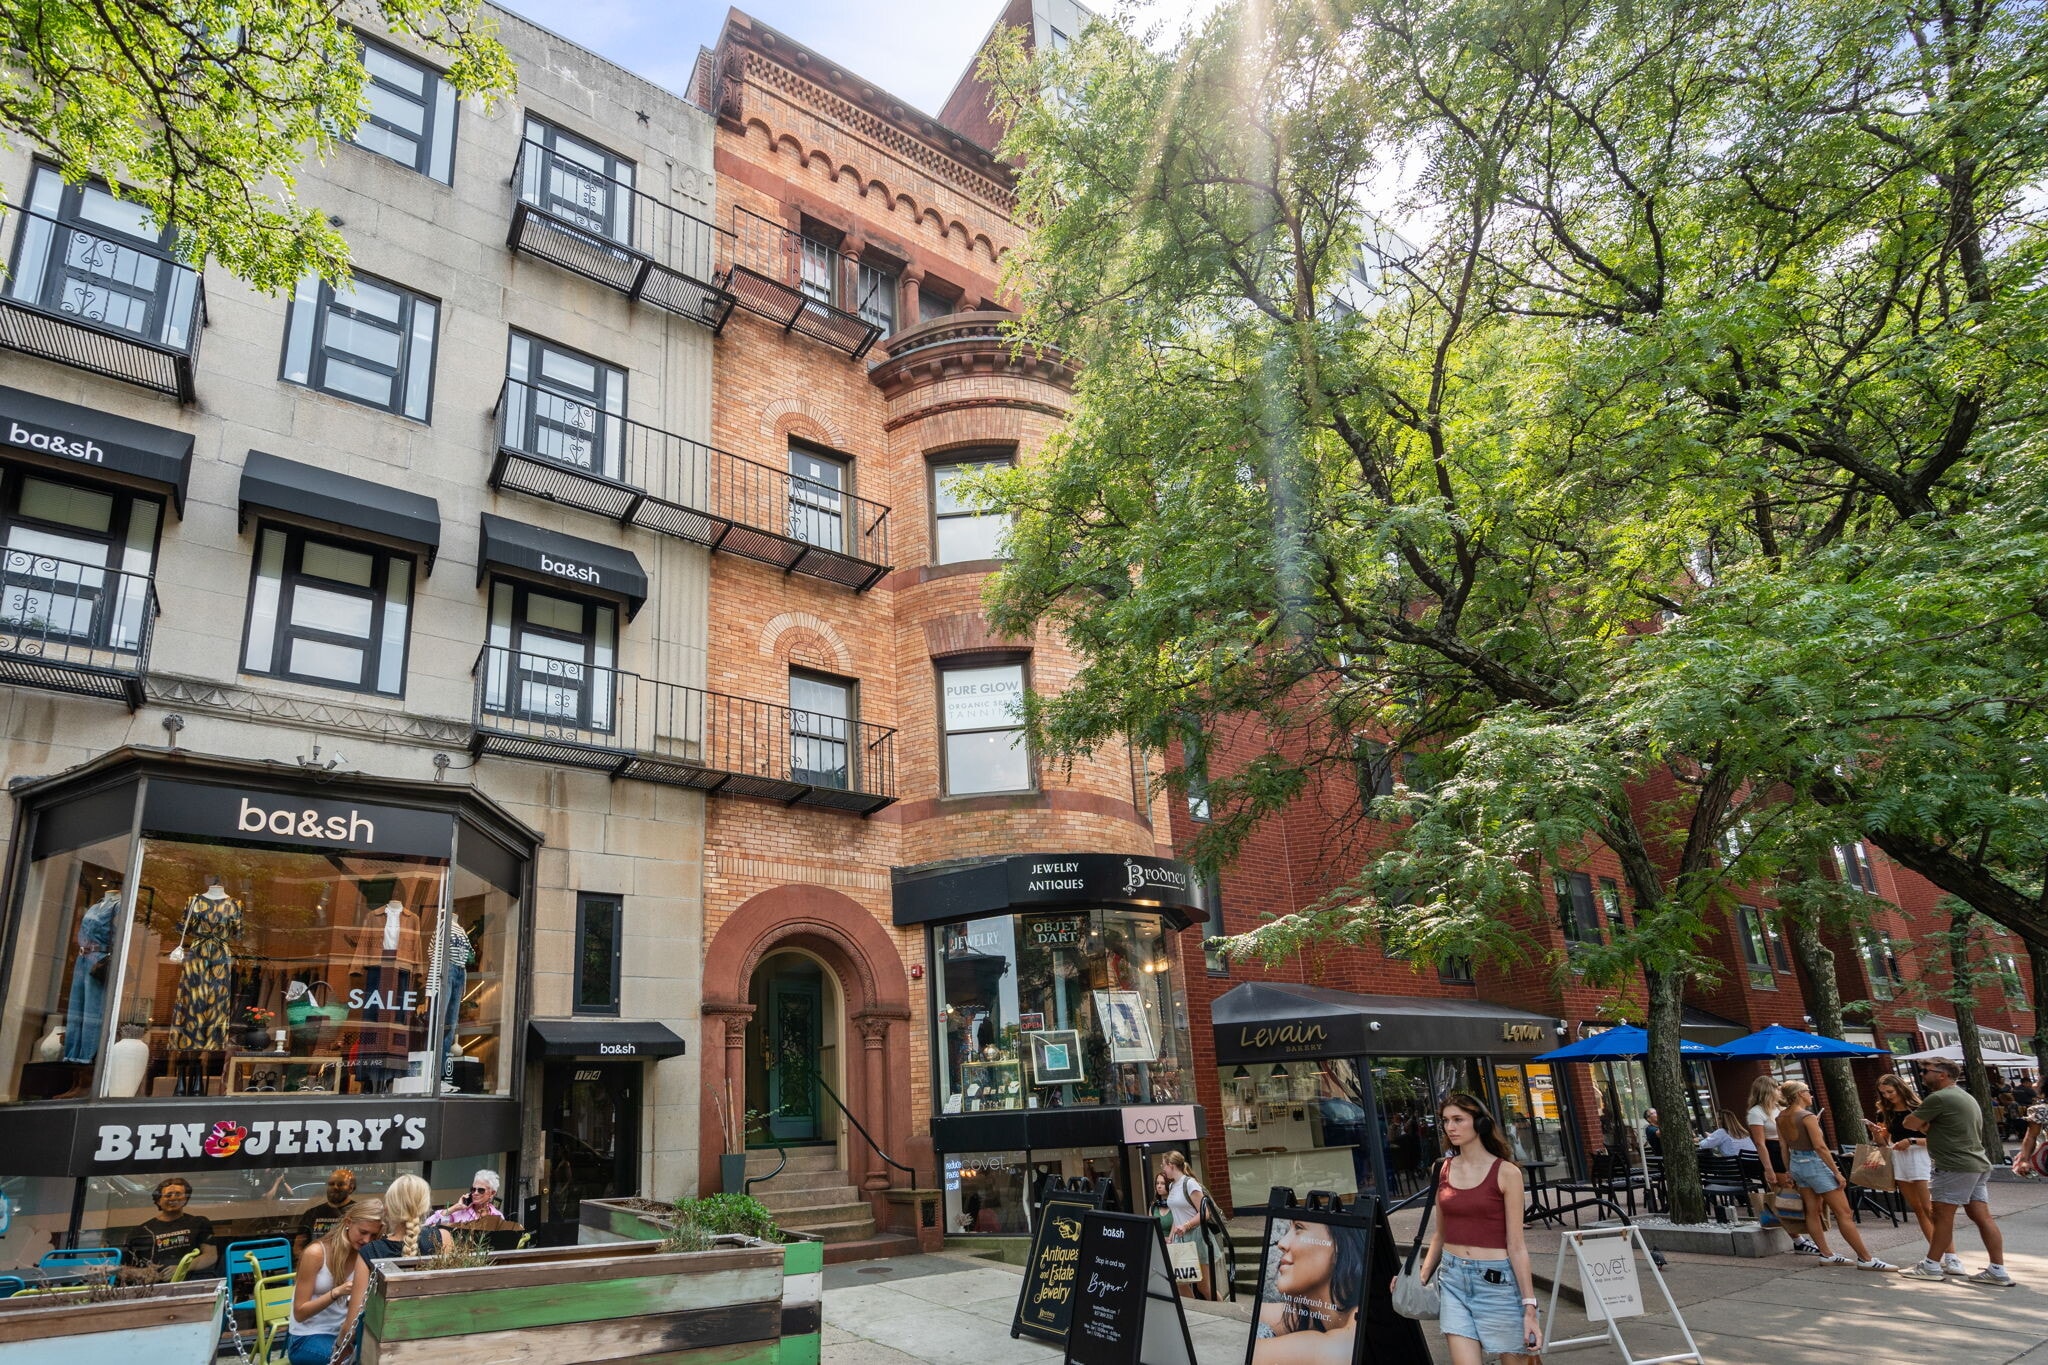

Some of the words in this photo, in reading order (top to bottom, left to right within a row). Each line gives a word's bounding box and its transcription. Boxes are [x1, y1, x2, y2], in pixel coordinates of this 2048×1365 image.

[9, 422, 104, 463] ba&sh
[541, 554, 600, 584] ba&sh
[946, 684, 977, 697] PURE
[980, 681, 1019, 694] GLOW
[948, 700, 990, 710] ORGANIC
[949, 709, 1005, 719] TANNIN
[238, 797, 375, 844] ba&sh
[1031, 862, 1080, 875] JEWELRY
[1122, 857, 1187, 896] Brodney
[1028, 879, 1084, 892] ANTIQUES
[1033, 920, 1079, 933] OBJET
[952, 930, 1000, 950] JEWELRY
[1038, 932, 1077, 944] D'ART
[347, 988, 418, 1011] SALE
[1022, 1021, 1042, 1030] OPEN
[1240, 1020, 1328, 1048] Levain
[600, 1043, 636, 1055] ba&sh
[1285, 1043, 1322, 1053] BAKERY
[574, 1070, 602, 1081] 174
[1134, 1111, 1185, 1135] covet
[94, 1122, 205, 1161] BEN
[204, 1120, 248, 1158] &
[244, 1112, 427, 1156] JERRY'S
[962, 1153, 1006, 1172] covet
[1102, 1225, 1125, 1239] ba&sh
[1040, 1245, 1079, 1269] Antiques
[1040, 1268, 1049, 1280] and
[1049, 1263, 1075, 1286] Estate
[1175, 1266, 1198, 1280] AVA
[1033, 1282, 1071, 1305] Jewelry
[1281, 1291, 1292, 1302] An
[1293, 1294, 1323, 1308] airbrush
[1324, 1301, 1338, 1311] tan
[1283, 1303, 1297, 1314] like
[1299, 1308, 1309, 1317] no
[1309, 1310, 1332, 1322] other.
